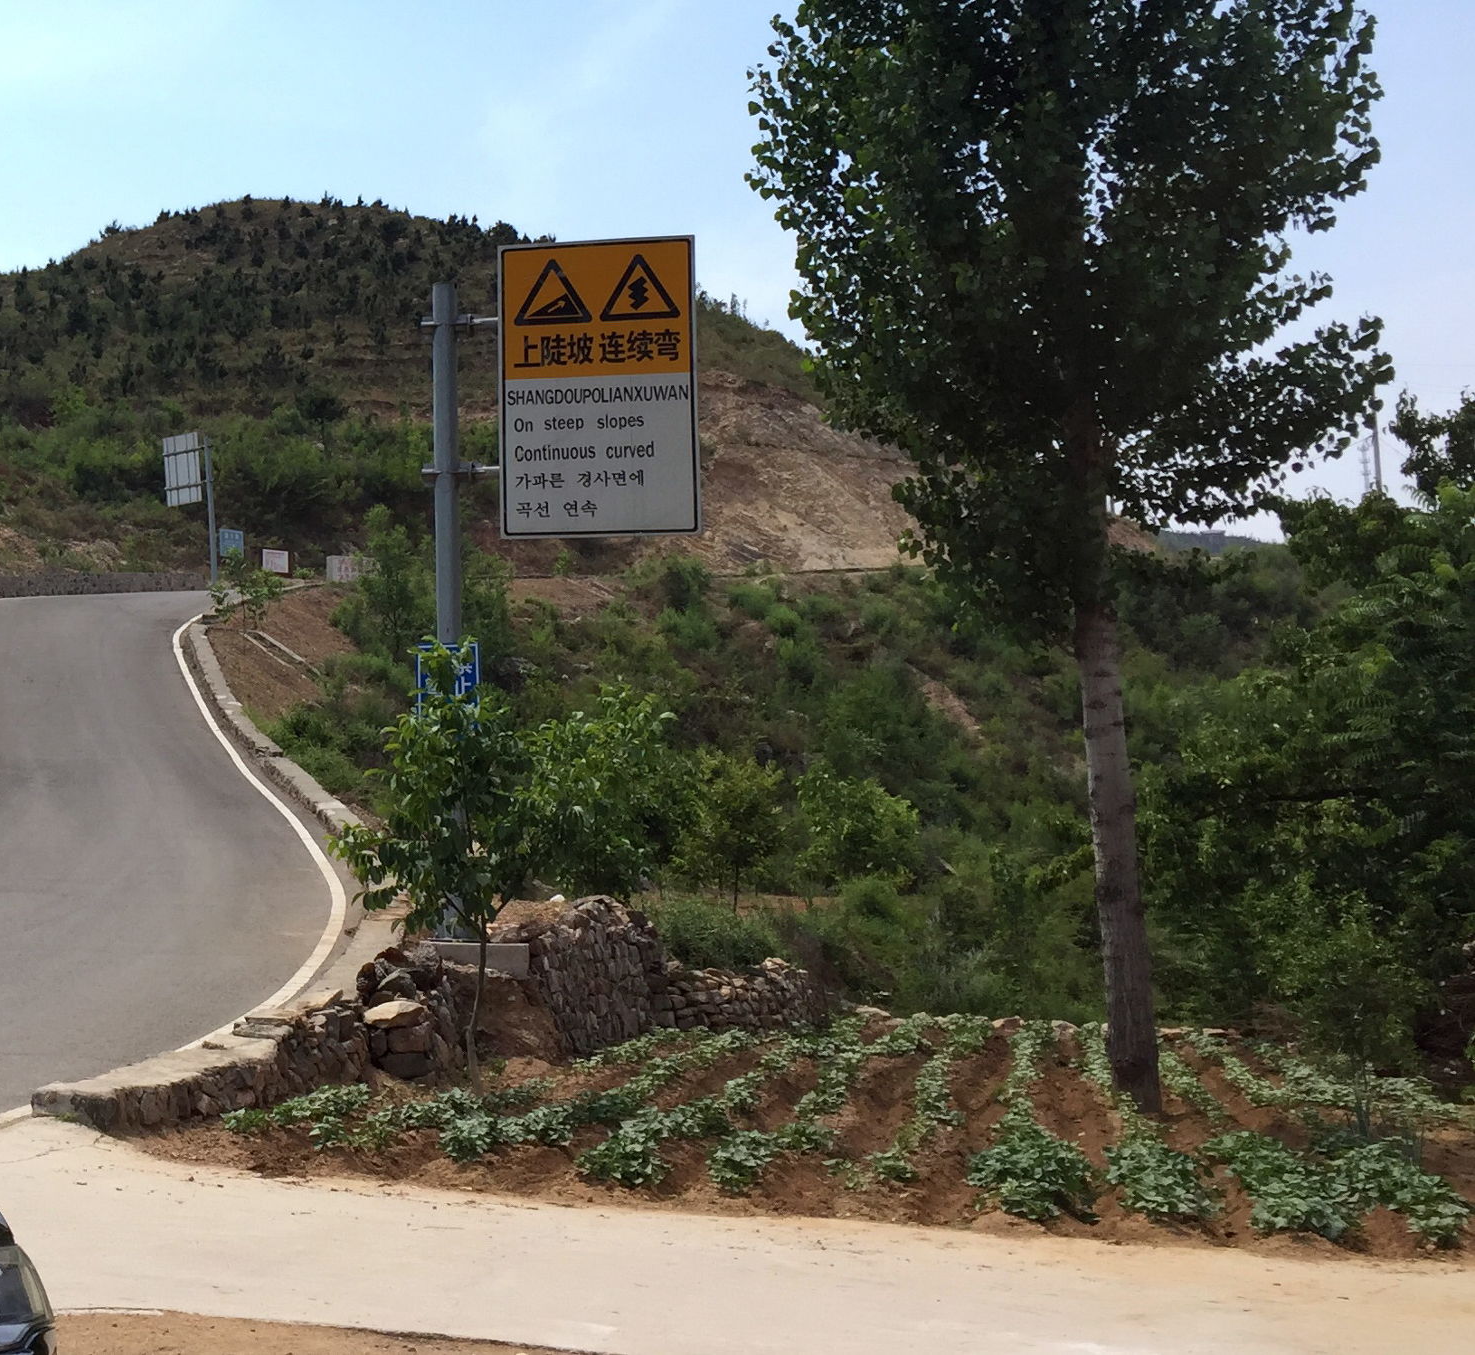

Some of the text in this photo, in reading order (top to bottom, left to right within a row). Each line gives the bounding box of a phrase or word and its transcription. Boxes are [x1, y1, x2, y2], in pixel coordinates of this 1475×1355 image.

[513, 329, 682, 369] 上陡坡 连续弯
[507, 385, 689, 406] SHANGDOUPOLIANXUWAN
[514, 413, 645, 433] On steep slopes
[514, 440, 655, 462] Continuous curved
[577, 469, 645, 488] 경사면에
[515, 499, 598, 519] 곡선 연속
